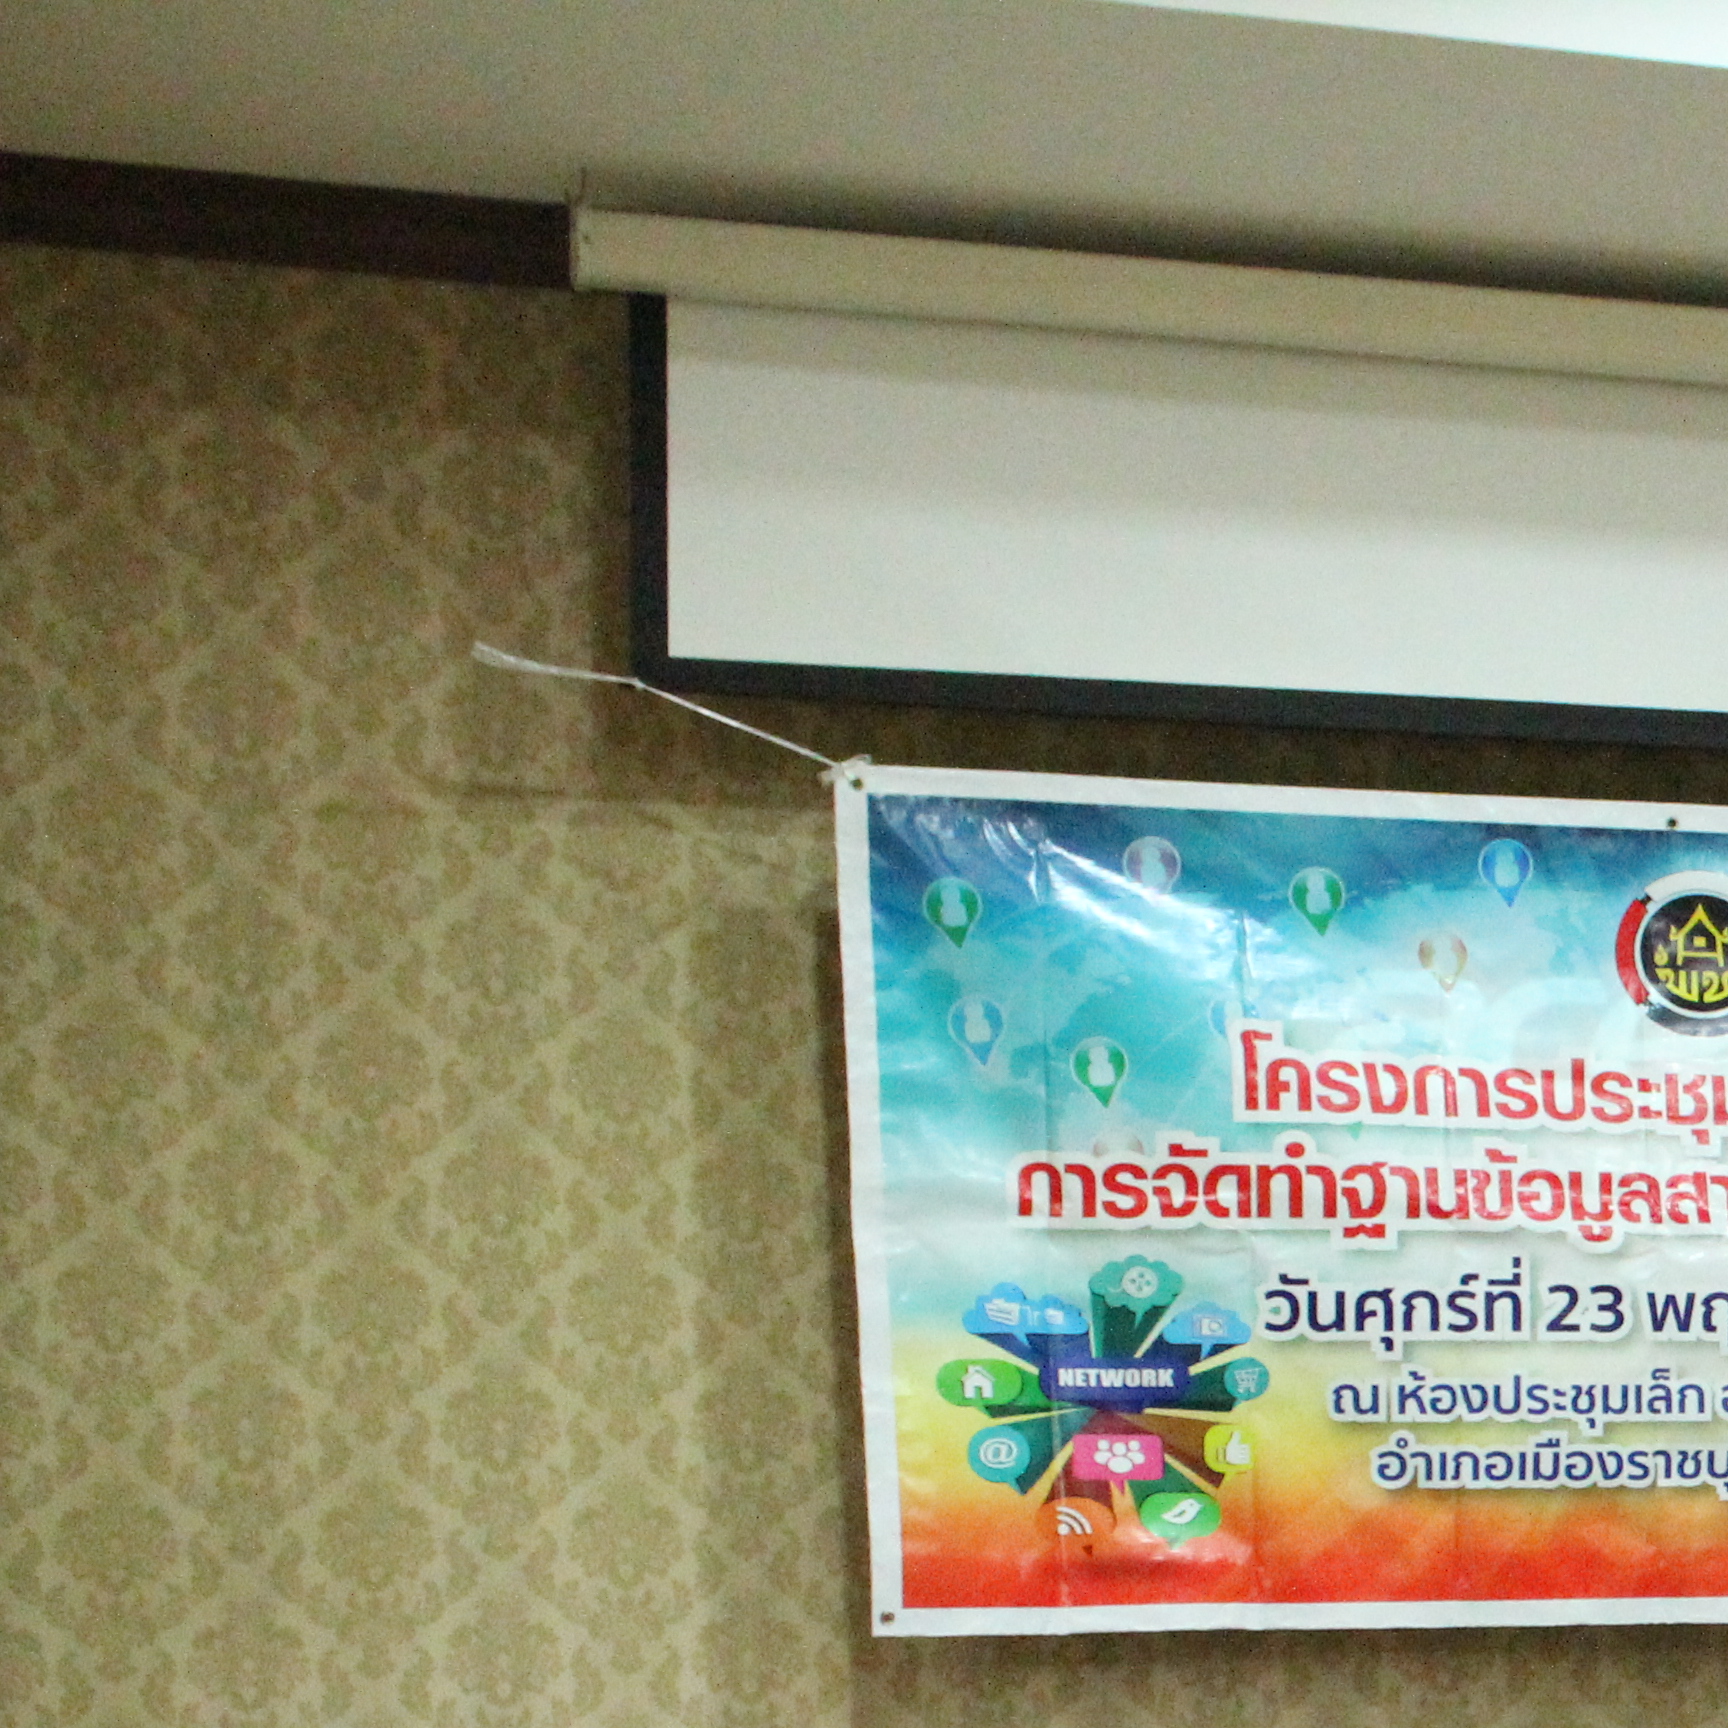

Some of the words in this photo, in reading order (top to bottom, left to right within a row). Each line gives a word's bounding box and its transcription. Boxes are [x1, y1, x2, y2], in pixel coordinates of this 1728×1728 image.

[1264, 1256, 1523, 1353] วันศุกร์ที่
[1546, 1284, 1626, 1333] 23
[1057, 1365, 1175, 1391] NETWORK
[1332, 1384, 1380, 1415] ณ
[1397, 1367, 1706, 1429] ห้องประชุมเล็ก
